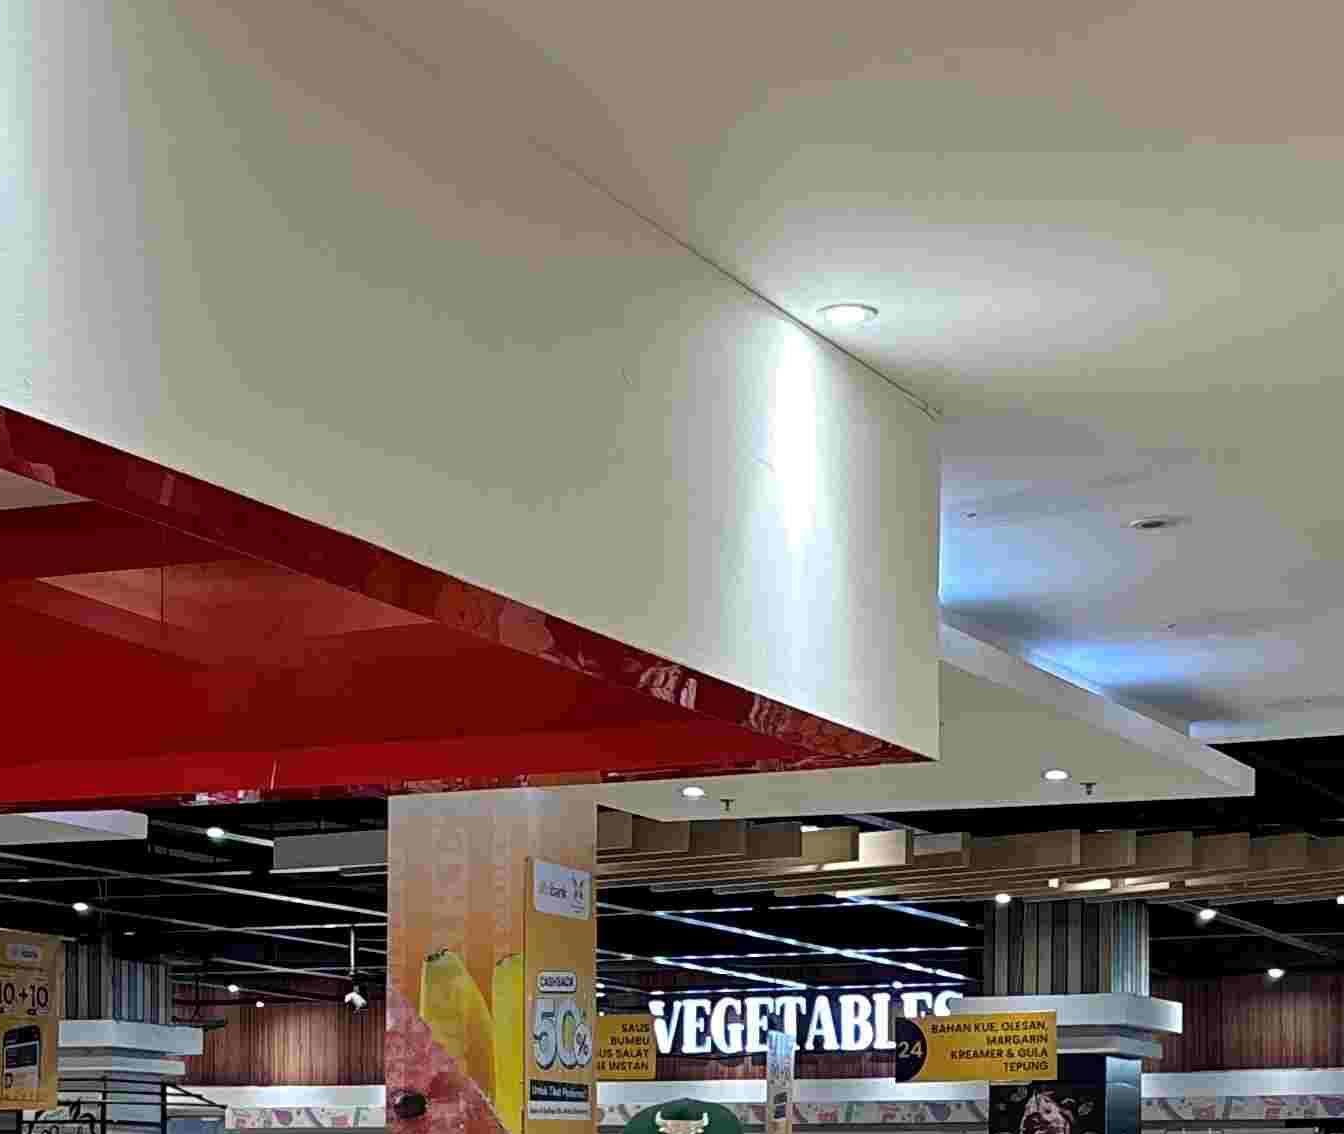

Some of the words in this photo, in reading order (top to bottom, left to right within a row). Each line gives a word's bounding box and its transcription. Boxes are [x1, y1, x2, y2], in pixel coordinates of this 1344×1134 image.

[931, 1022, 971, 1034] BAHAN
[986, 1034, 1048, 1046] MARGARIN
[896, 1041, 924, 1059] 24
[1003, 1060, 1049, 1072] TEPUNG
